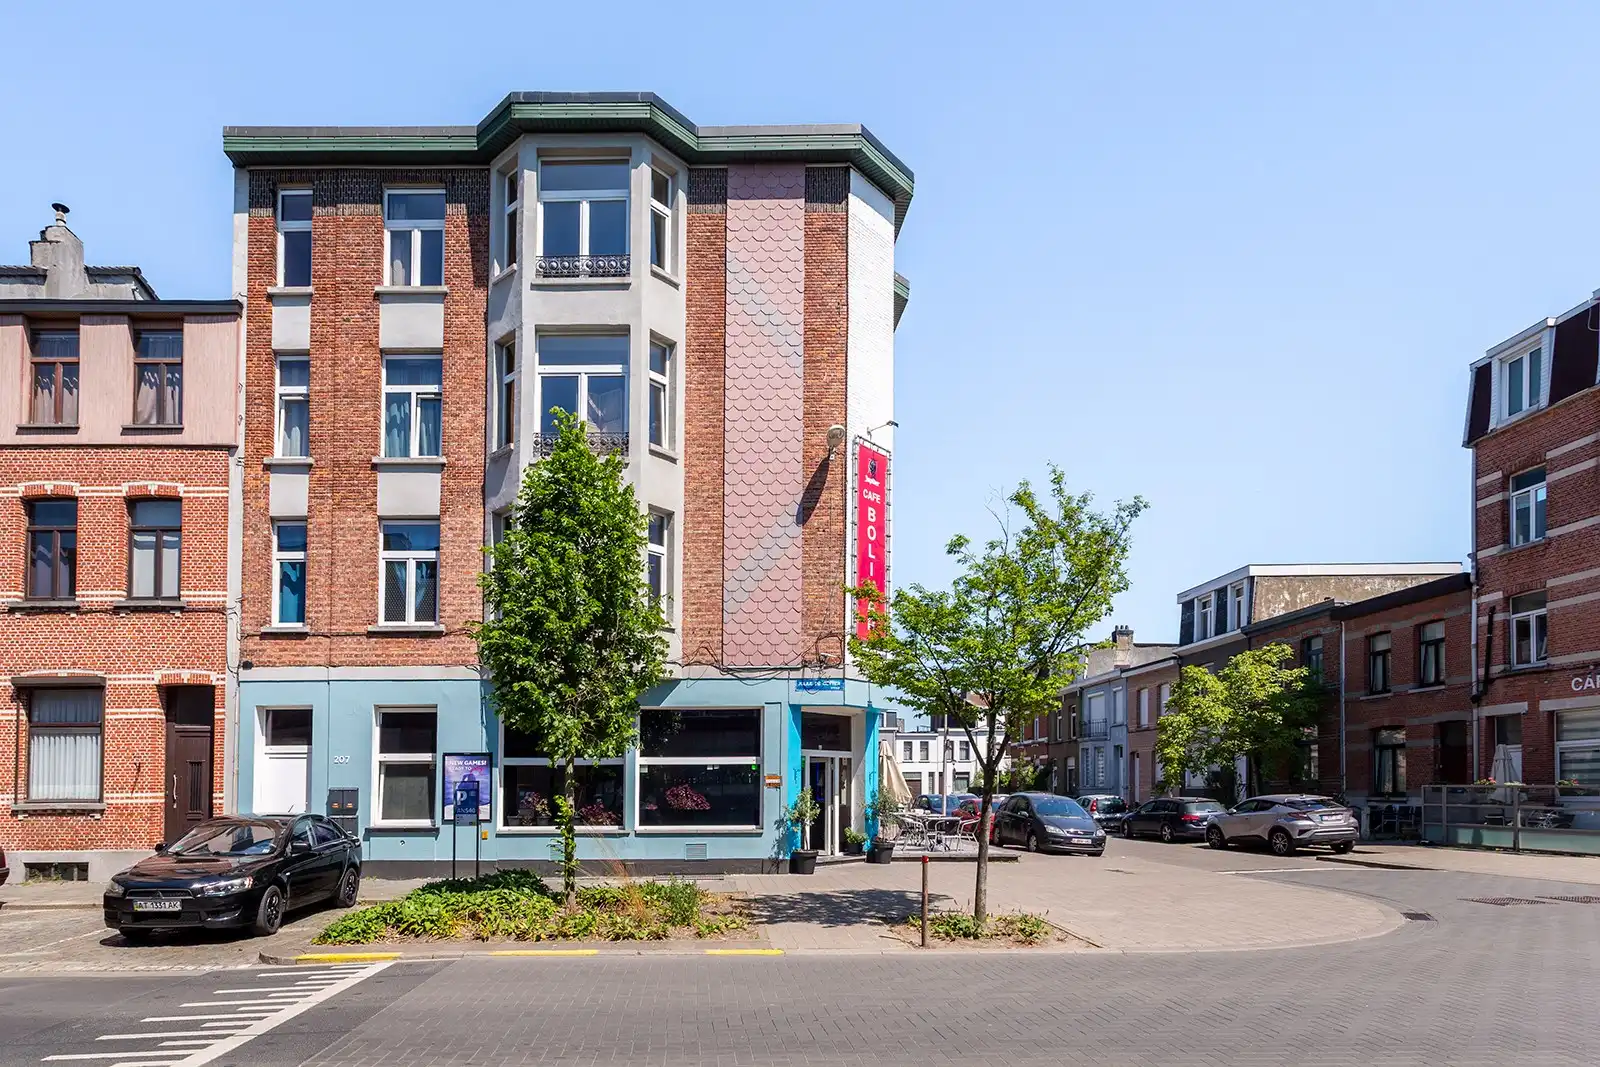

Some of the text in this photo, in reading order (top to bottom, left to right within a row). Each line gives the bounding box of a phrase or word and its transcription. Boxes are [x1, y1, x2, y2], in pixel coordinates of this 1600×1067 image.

[862, 488, 881, 504] CAFE
[866, 506, 876, 631] BOLIAR
[334, 755, 350, 763] 207
[456, 790, 468, 806] P
